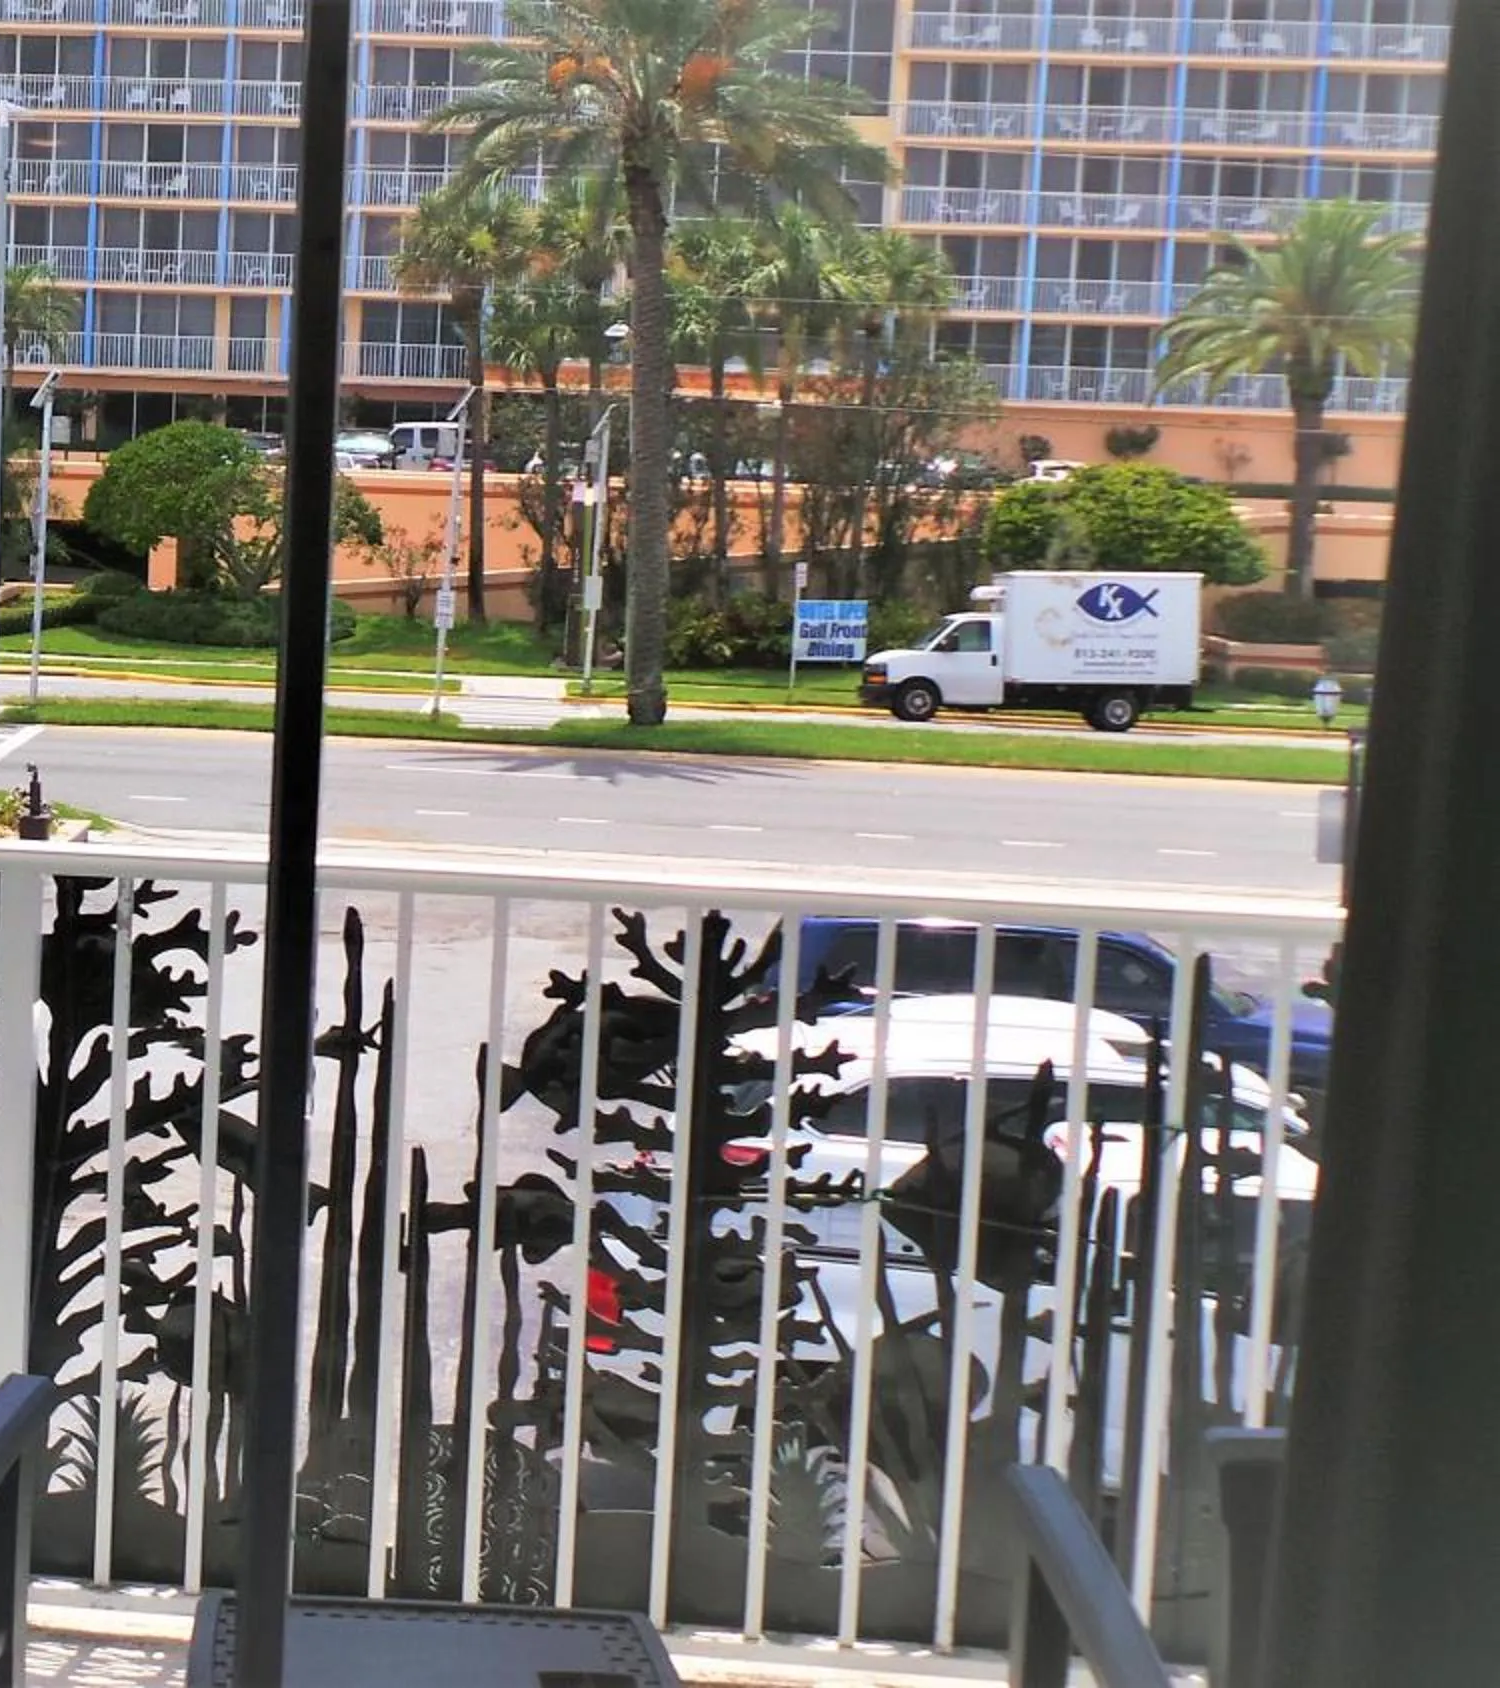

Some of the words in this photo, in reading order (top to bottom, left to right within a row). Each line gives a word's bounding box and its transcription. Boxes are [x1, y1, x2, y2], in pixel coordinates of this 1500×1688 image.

[799, 622, 827, 639] Gulf
[830, 622, 868, 639] Front
[808, 641, 855, 658] Dining
